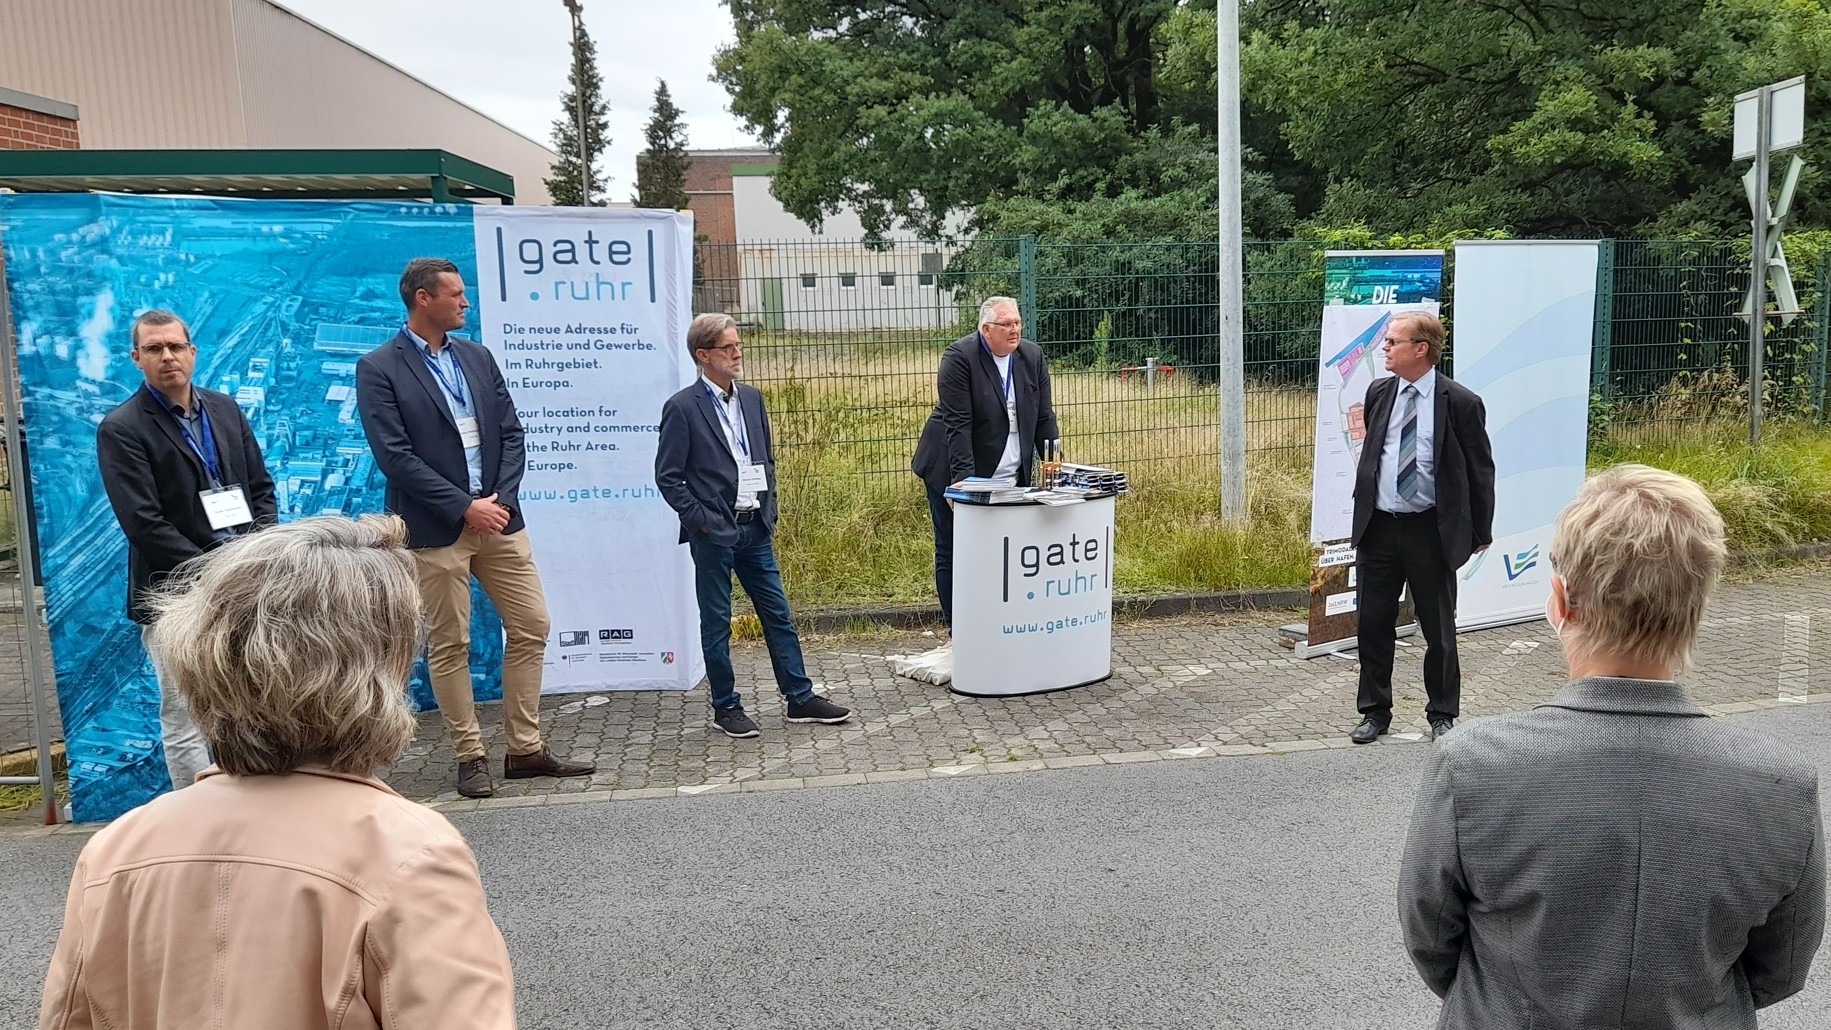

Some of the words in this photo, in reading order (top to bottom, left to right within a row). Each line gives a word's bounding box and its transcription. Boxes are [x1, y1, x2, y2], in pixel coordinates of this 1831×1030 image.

[518, 229, 632, 275] gate
[529, 272, 633, 301] .ruhr
[1371, 285, 1400, 304] DIE
[503, 323, 526, 335] Die
[528, 325, 561, 335] neue
[564, 323, 617, 335] Adresse
[620, 322, 640, 335] für
[504, 339, 563, 351] Industrie
[566, 339, 591, 351] und
[593, 338, 657, 351] Gewerbe.
[505, 358, 522, 370] Im
[525, 357, 602, 372] Ruhrgebiet.
[506, 377, 519, 389] In
[522, 377, 574, 391] Europa.
[514, 406, 540, 419] our
[542, 405, 595, 418] location
[598, 405, 618, 418] for
[522, 422, 564, 436] dustry
[566, 421, 591, 433] and
[593, 423, 660, 433] commerce
[526, 440, 548, 453] the
[551, 439, 582, 452] Ruhr
[585, 441, 620, 451] Area.
[527, 459, 578, 473] Europe.
[1020, 533, 1098, 578] gate
[1026, 569, 1098, 600] .ruhr
[1003, 609, 1107, 634] www.gate.ruhr
[600, 630, 633, 639] RAG
